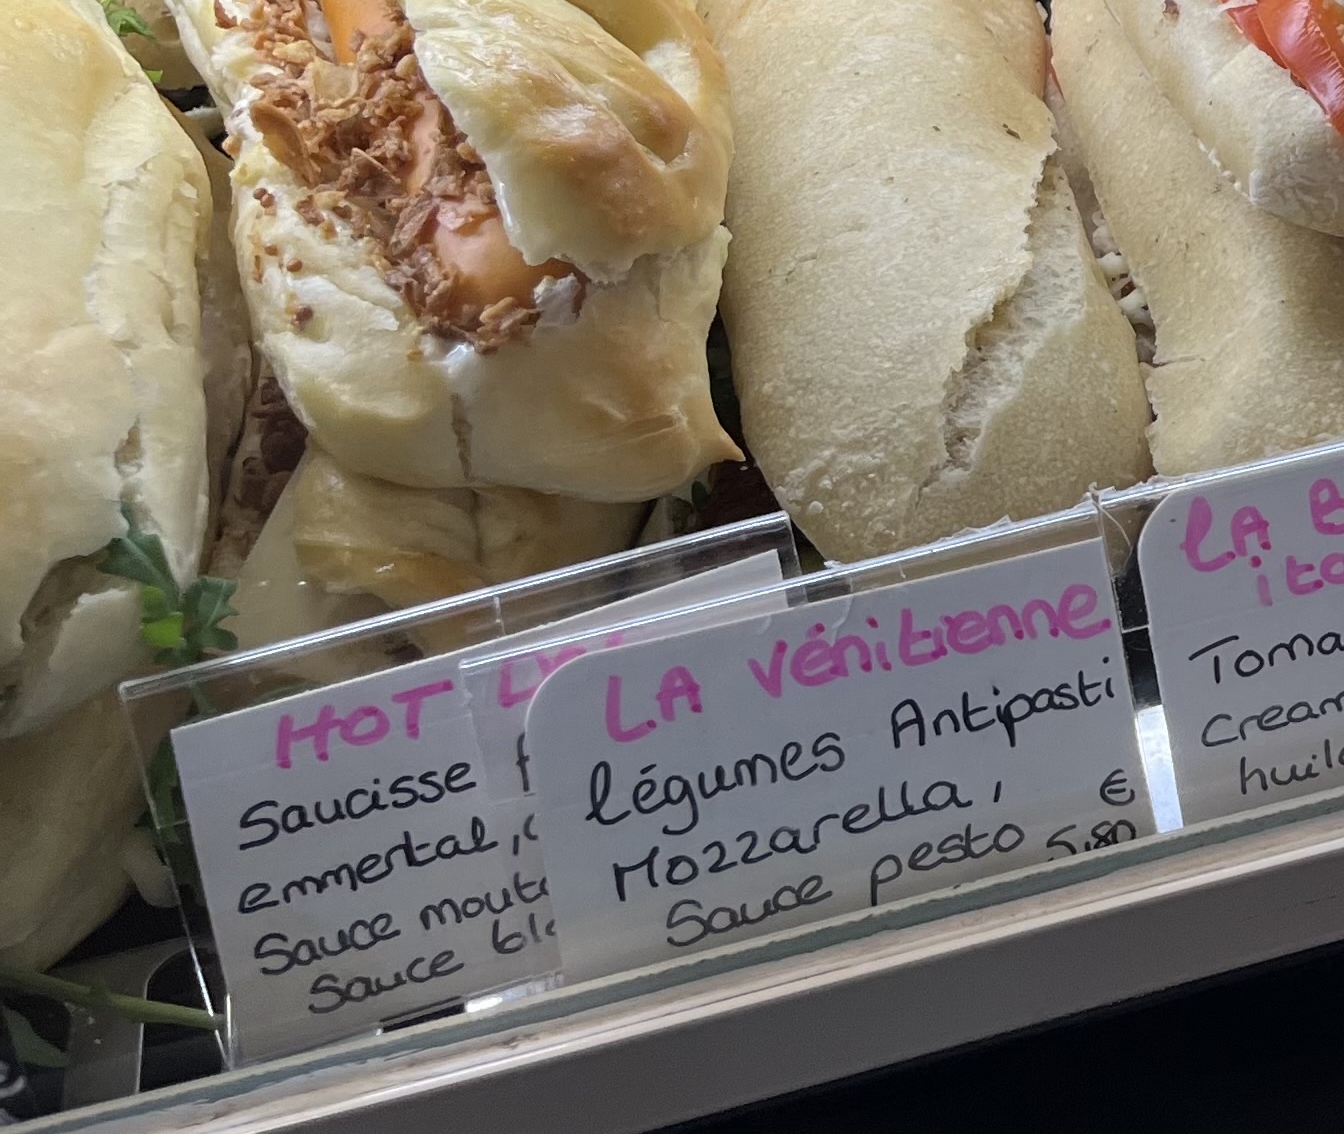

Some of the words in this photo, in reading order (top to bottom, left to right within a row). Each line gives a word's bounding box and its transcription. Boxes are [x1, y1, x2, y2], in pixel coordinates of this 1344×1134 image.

[275, 680, 453, 768] HOT
[606, 666, 703, 742] LA
[891, 657, 1115, 748] Antipasti
[239, 762, 477, 851] Saucisse
[1100, 768, 1135, 806] €
[667, 875, 833, 947] Sauce
[871, 822, 1025, 906] pesto
[255, 913, 400, 975] Sauce
[308, 949, 465, 1014] Sauce
